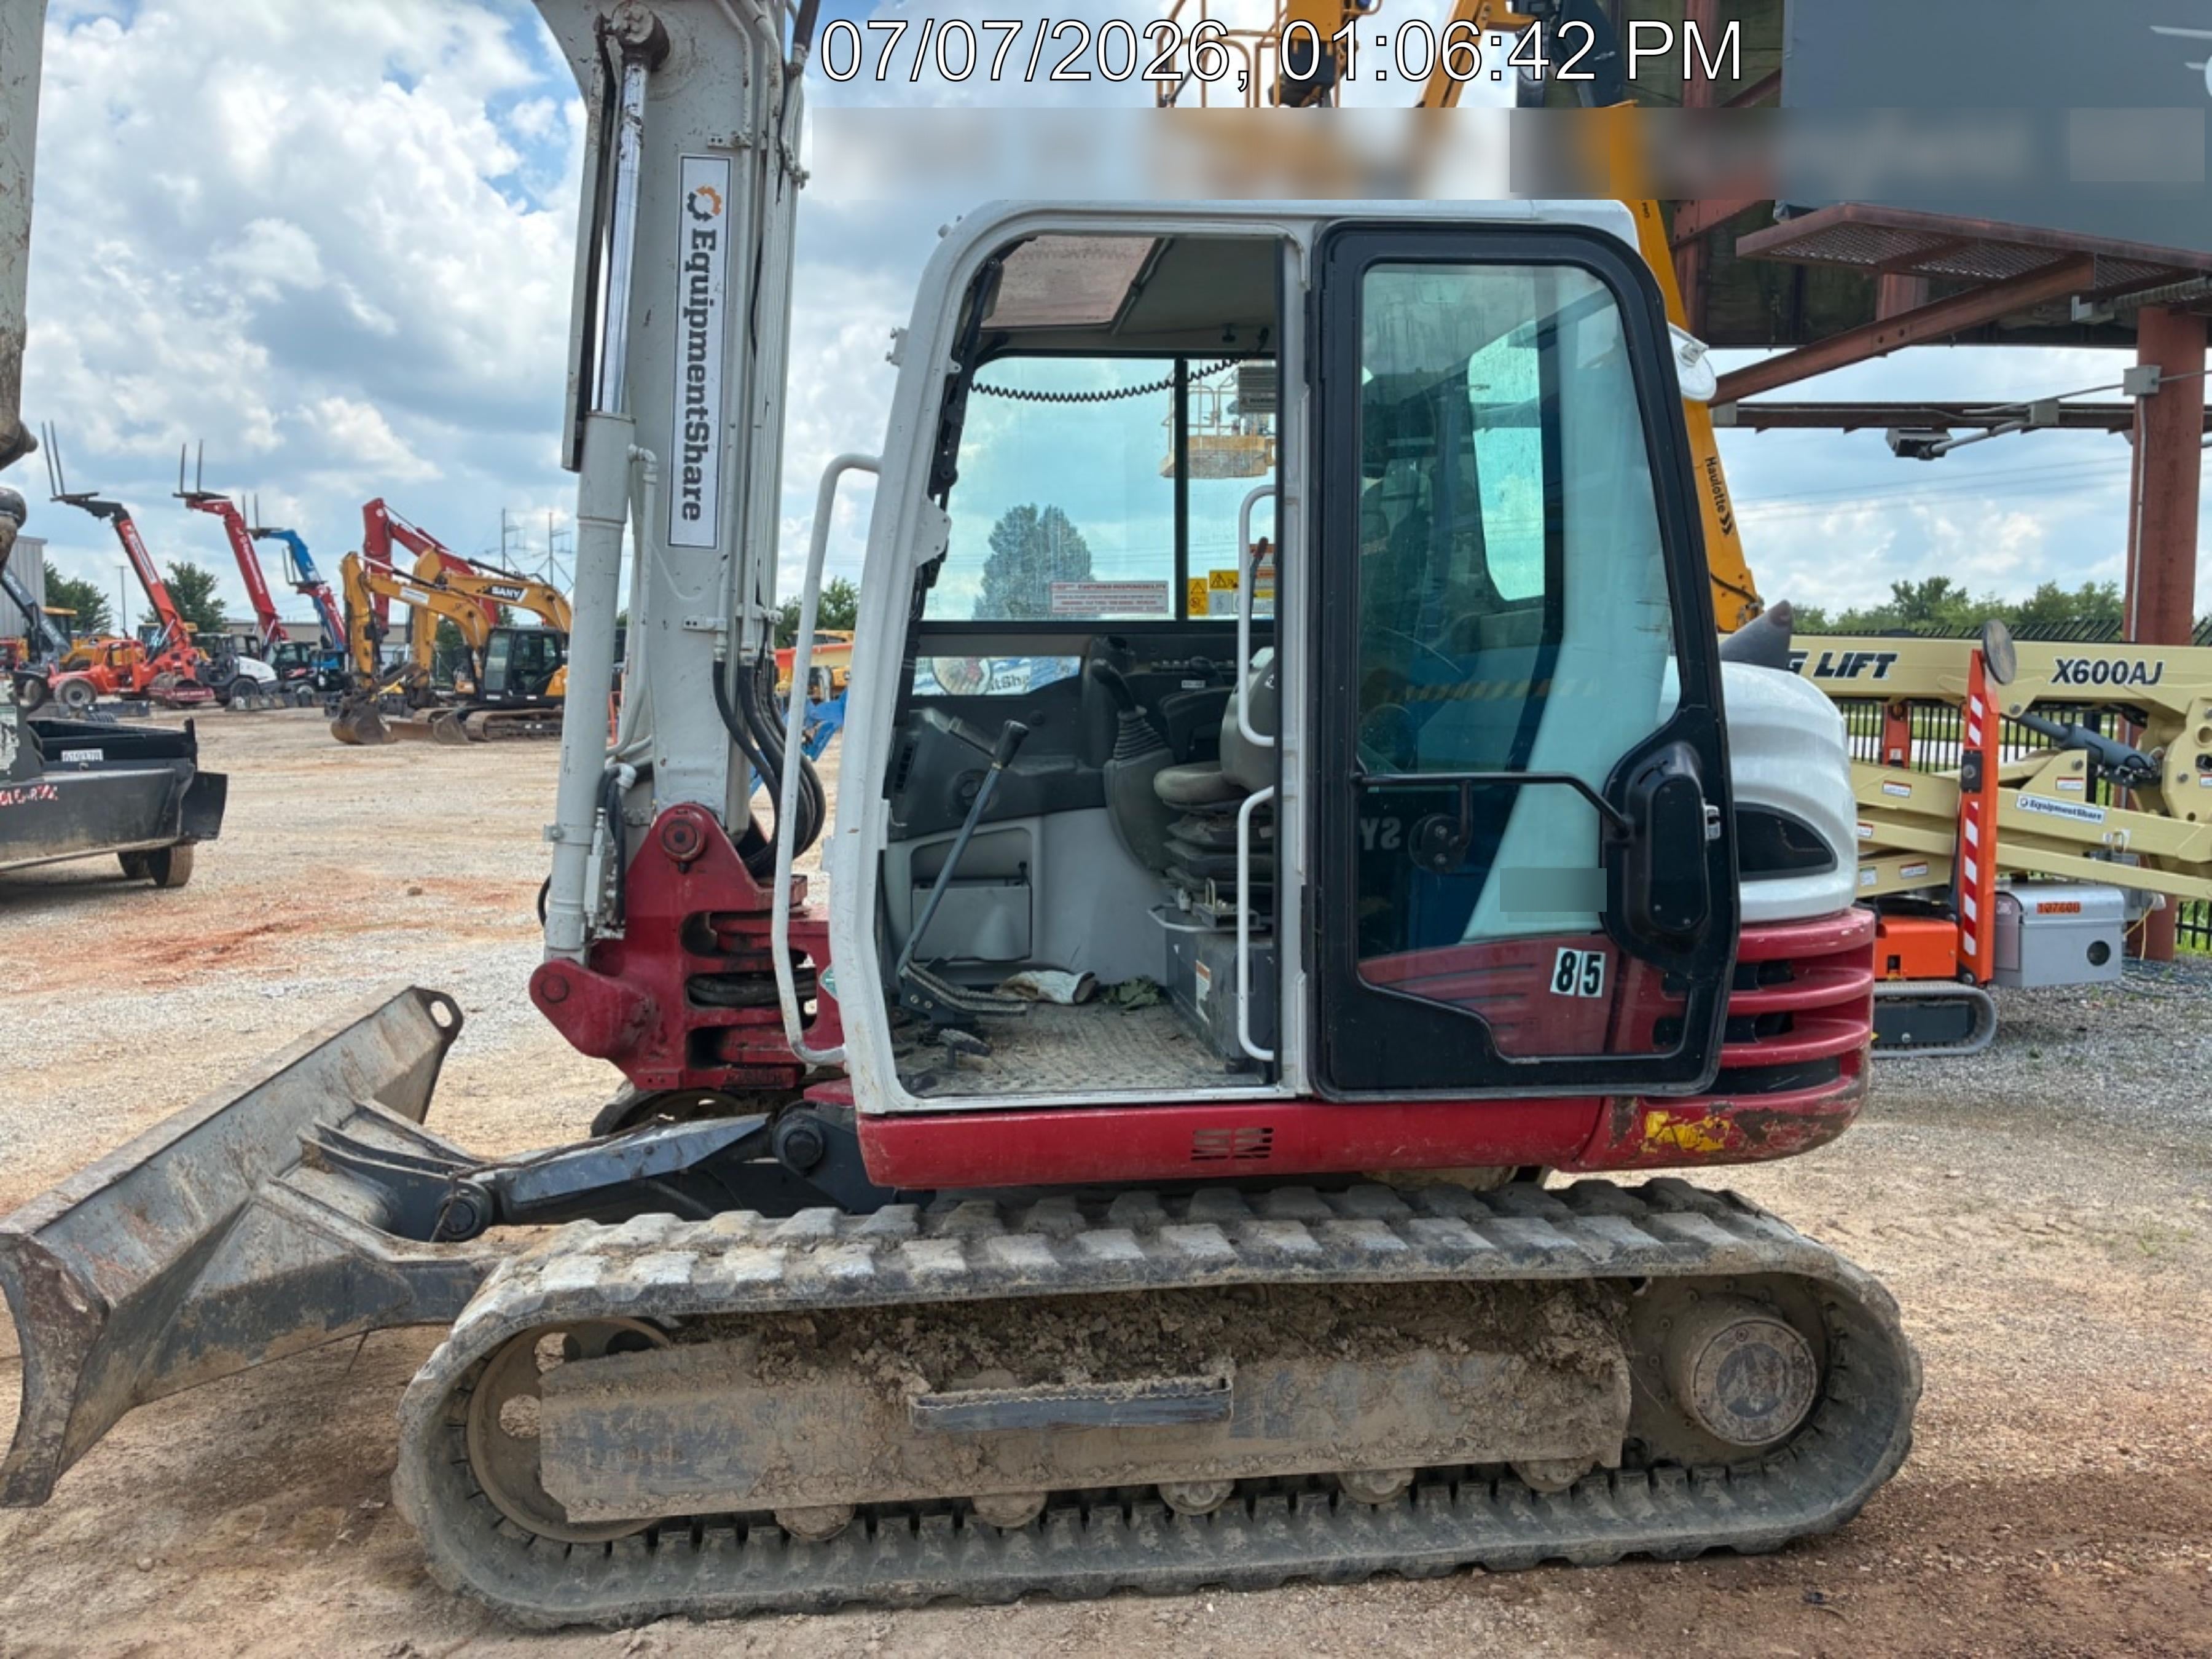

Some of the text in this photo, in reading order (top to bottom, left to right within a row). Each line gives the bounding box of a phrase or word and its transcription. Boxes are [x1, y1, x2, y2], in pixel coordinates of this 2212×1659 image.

[682, 229, 716, 522] EquipmentShare
[489, 586, 522, 600] SANY
[1813, 652, 1899, 679] LIFT
[2051, 658, 2163, 685] X600AJ
[1556, 951, 1602, 995] 85
